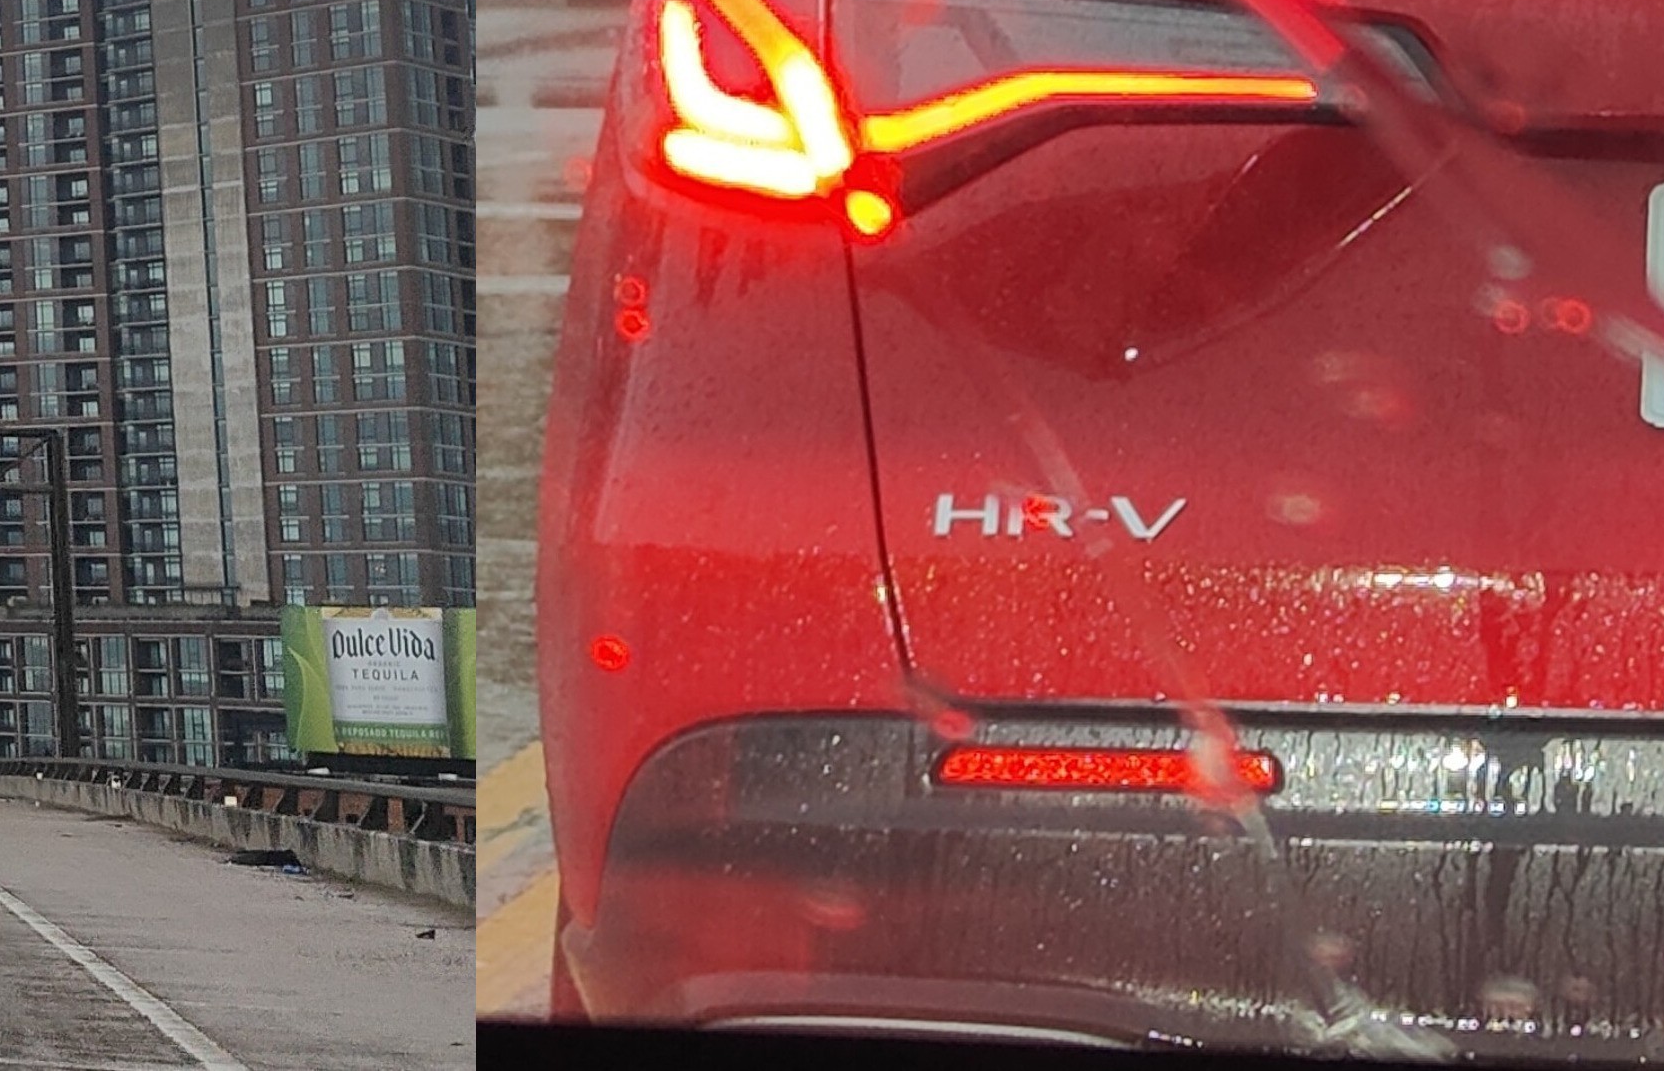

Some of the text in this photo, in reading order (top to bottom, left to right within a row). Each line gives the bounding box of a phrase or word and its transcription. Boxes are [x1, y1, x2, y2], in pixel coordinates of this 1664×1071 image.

[933, 493, 1186, 540] HR-V
[332, 628, 385, 660] Dulce
[352, 669, 419, 681] TEQUILA
